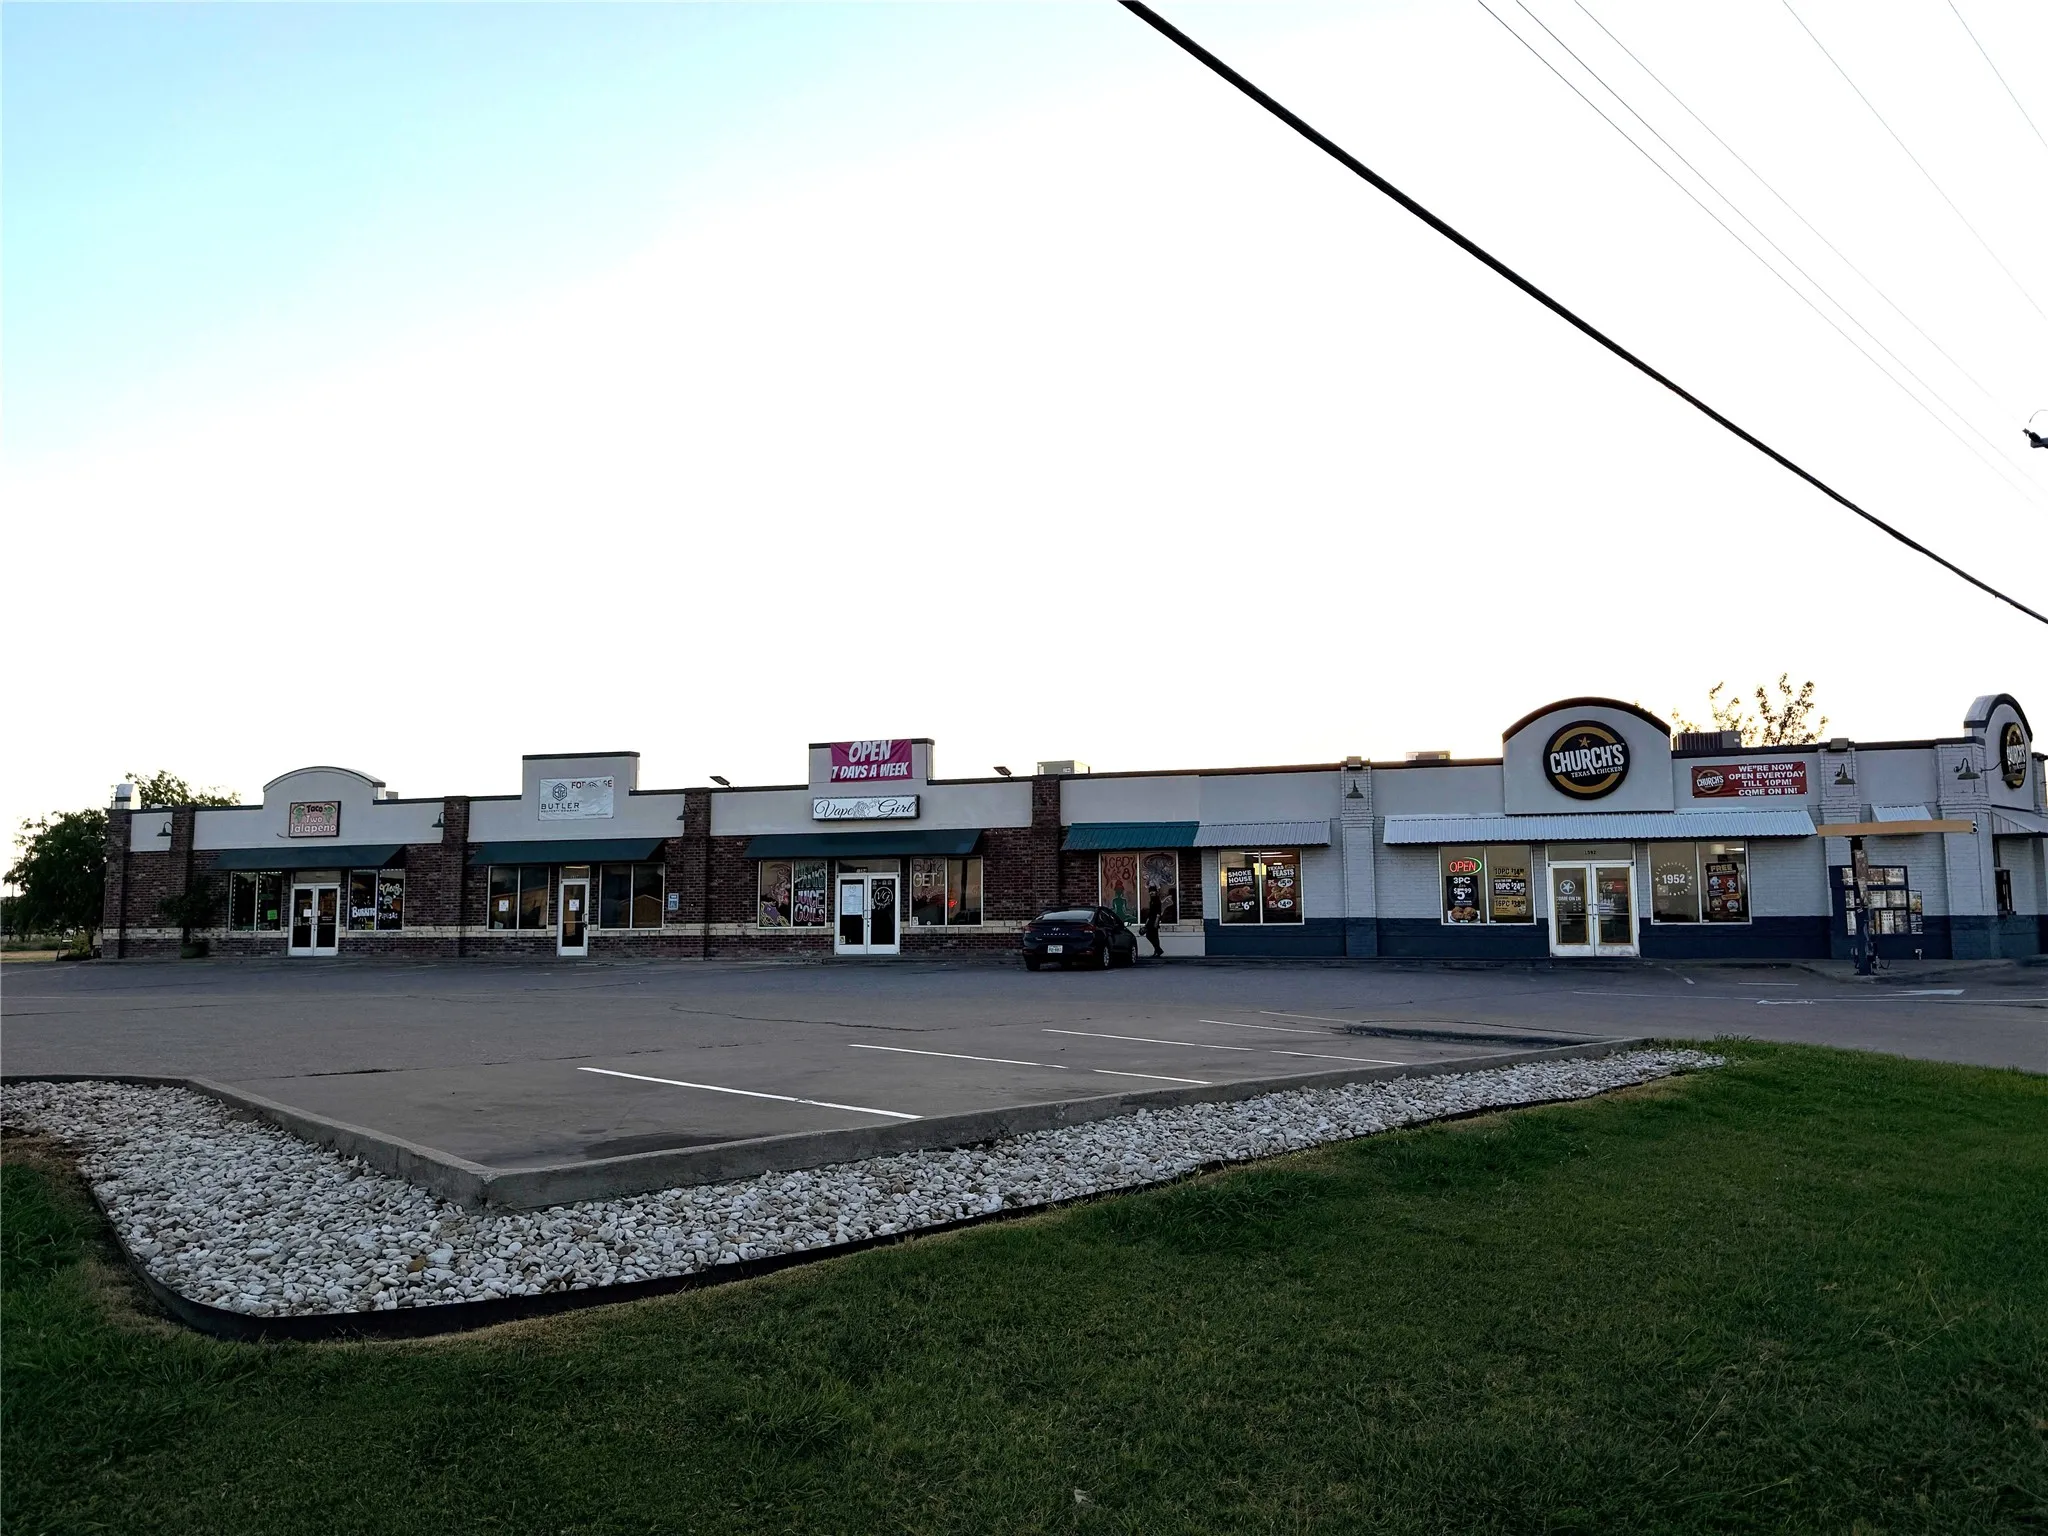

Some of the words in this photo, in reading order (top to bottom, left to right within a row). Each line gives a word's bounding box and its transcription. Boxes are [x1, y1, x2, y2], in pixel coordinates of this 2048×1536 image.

[848, 740, 892, 763] OPEN
[1550, 744, 1624, 774] CHURCH'S
[832, 766, 839, 779] 7
[840, 765, 868, 779] DAYS
[869, 764, 877, 777] A
[880, 762, 909, 777] WEEK
[1571, 770, 1591, 778] TEXAS
[1596, 766, 1623, 775] CHICKEN
[1756, 771, 1804, 779] EVERYDAY
[1697, 775, 1724, 787] CHURCH'S
[1738, 788, 1765, 796] COME
[306, 805, 323, 813] Taco
[815, 800, 854, 818] Vape
[877, 799, 915, 818] Girl
[305, 815, 323, 823] Two
[1449, 861, 1476, 872] OPEN
[1711, 864, 1733, 872] FREE
[1273, 869, 1295, 877] FEASTS
[1662, 873, 1686, 884] 1952
[913, 872, 937, 887] GET
[1228, 876, 1253, 884] HOUSE
[1494, 882, 1510, 890] 10PC
[795, 889, 825, 908] JUICE
[794, 903, 825, 922] COILS
